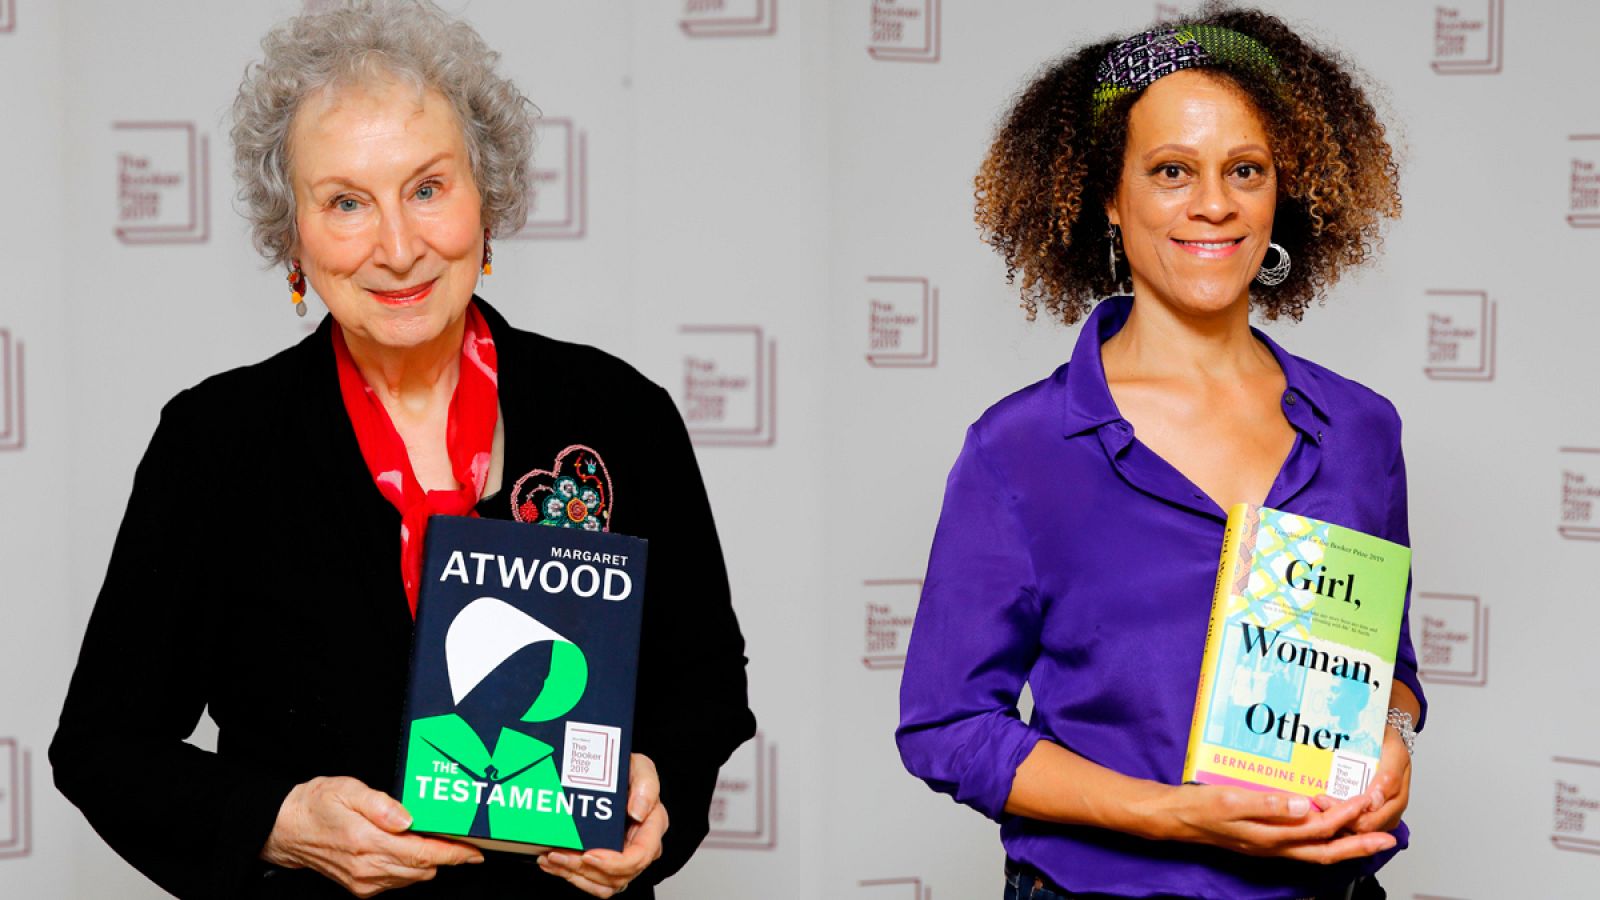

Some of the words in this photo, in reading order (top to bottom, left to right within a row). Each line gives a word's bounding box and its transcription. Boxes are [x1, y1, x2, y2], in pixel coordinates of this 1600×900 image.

[551, 547, 628, 566] MARGARET
[440, 551, 632, 601] ATWOOD
[1285, 559, 1361, 610] Girl,
[1240, 622, 1380, 692] Woman,
[1245, 703, 1350, 752] Other
[571, 750, 601, 761] Booker
[572, 743, 588, 752] The
[432, 761, 459, 775] THE
[570, 759, 591, 767] Prize
[570, 766, 589, 774] 2019
[1213, 753, 1295, 782] BERNARDINE
[416, 776, 613, 821] TESTAMENTS
